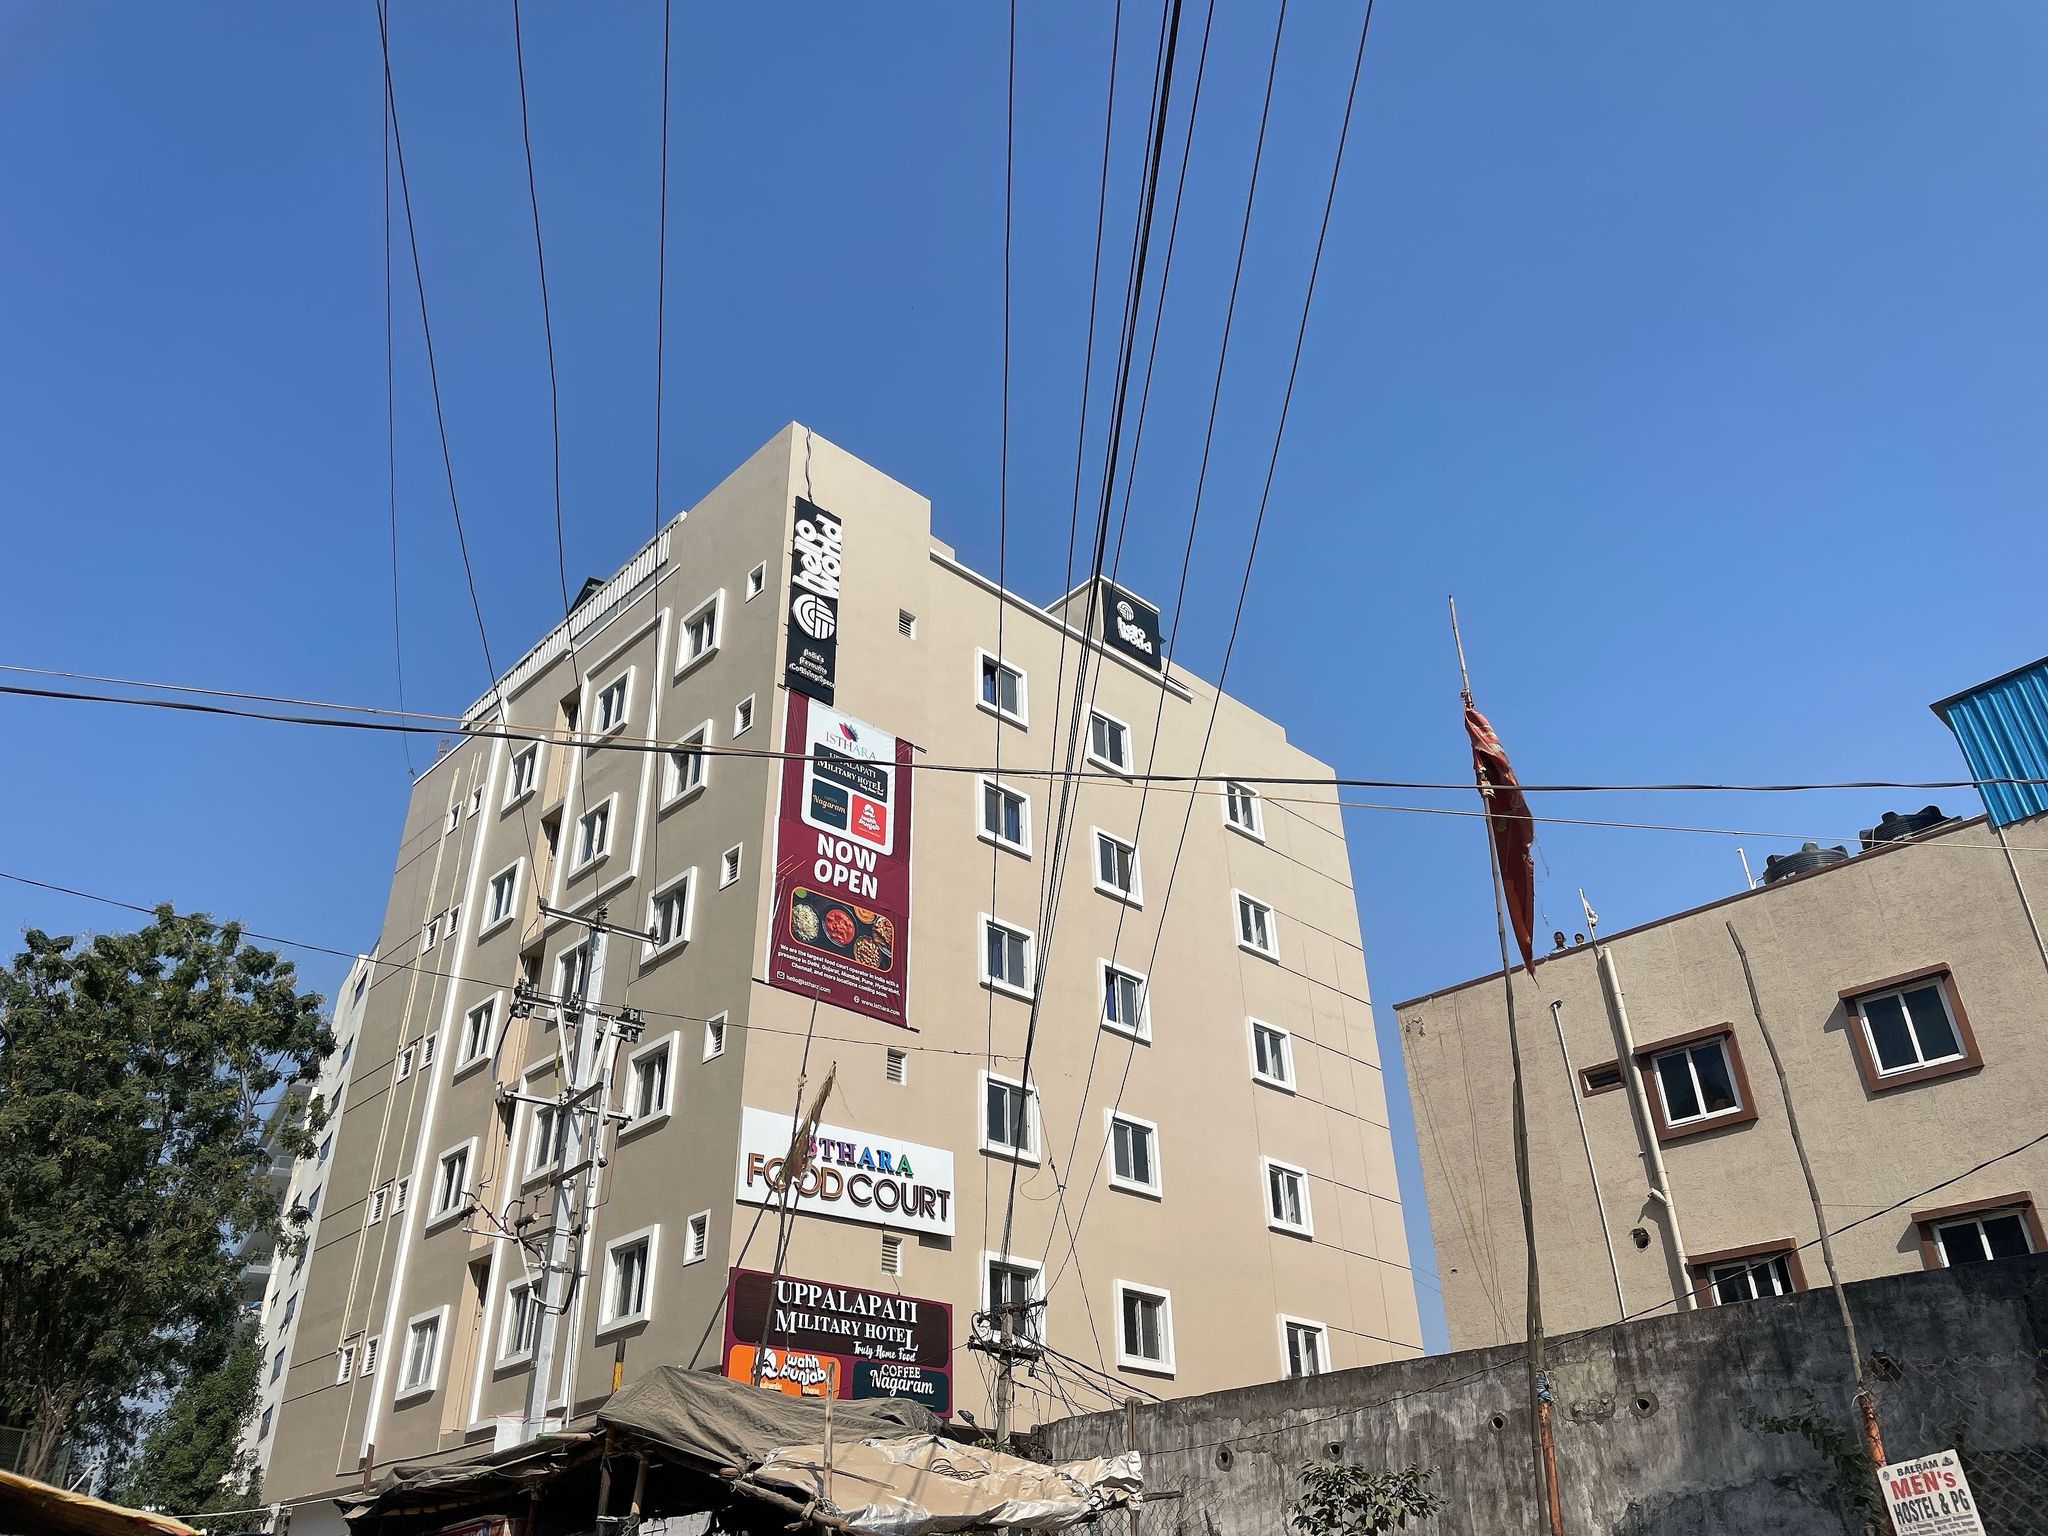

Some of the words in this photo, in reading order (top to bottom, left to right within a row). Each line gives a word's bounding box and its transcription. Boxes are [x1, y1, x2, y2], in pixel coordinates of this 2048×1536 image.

[792, 519, 823, 597] hello
[816, 513, 842, 600] world
[826, 731, 876, 760] ISTHARA
[817, 760, 857, 781] MILITARY
[857, 776, 884, 792] HOTEL
[817, 833, 877, 873] NOW
[813, 858, 878, 900] OPEN
[847, 1173, 951, 1219] COURT
[776, 1280, 919, 1324] UPPALAPATI
[775, 1309, 863, 1337] MILITARY
[865, 1323, 919, 1352] HOTEL
[786, 1354, 819, 1368] wahh
[853, 1341, 873, 1360] Truly
[875, 1345, 897, 1360] Home
[897, 1347, 917, 1362] Food
[780, 1362, 827, 1386] punjab
[869, 1369, 935, 1397] Nagaram
[881, 1364, 921, 1379] COFFEE
[1896, 1459, 1939, 1477] BALRAM
[1893, 1496, 1940, 1526] HOSTEL
[1938, 1493, 1951, 1515] &
[1950, 1488, 1971, 1513] PG
